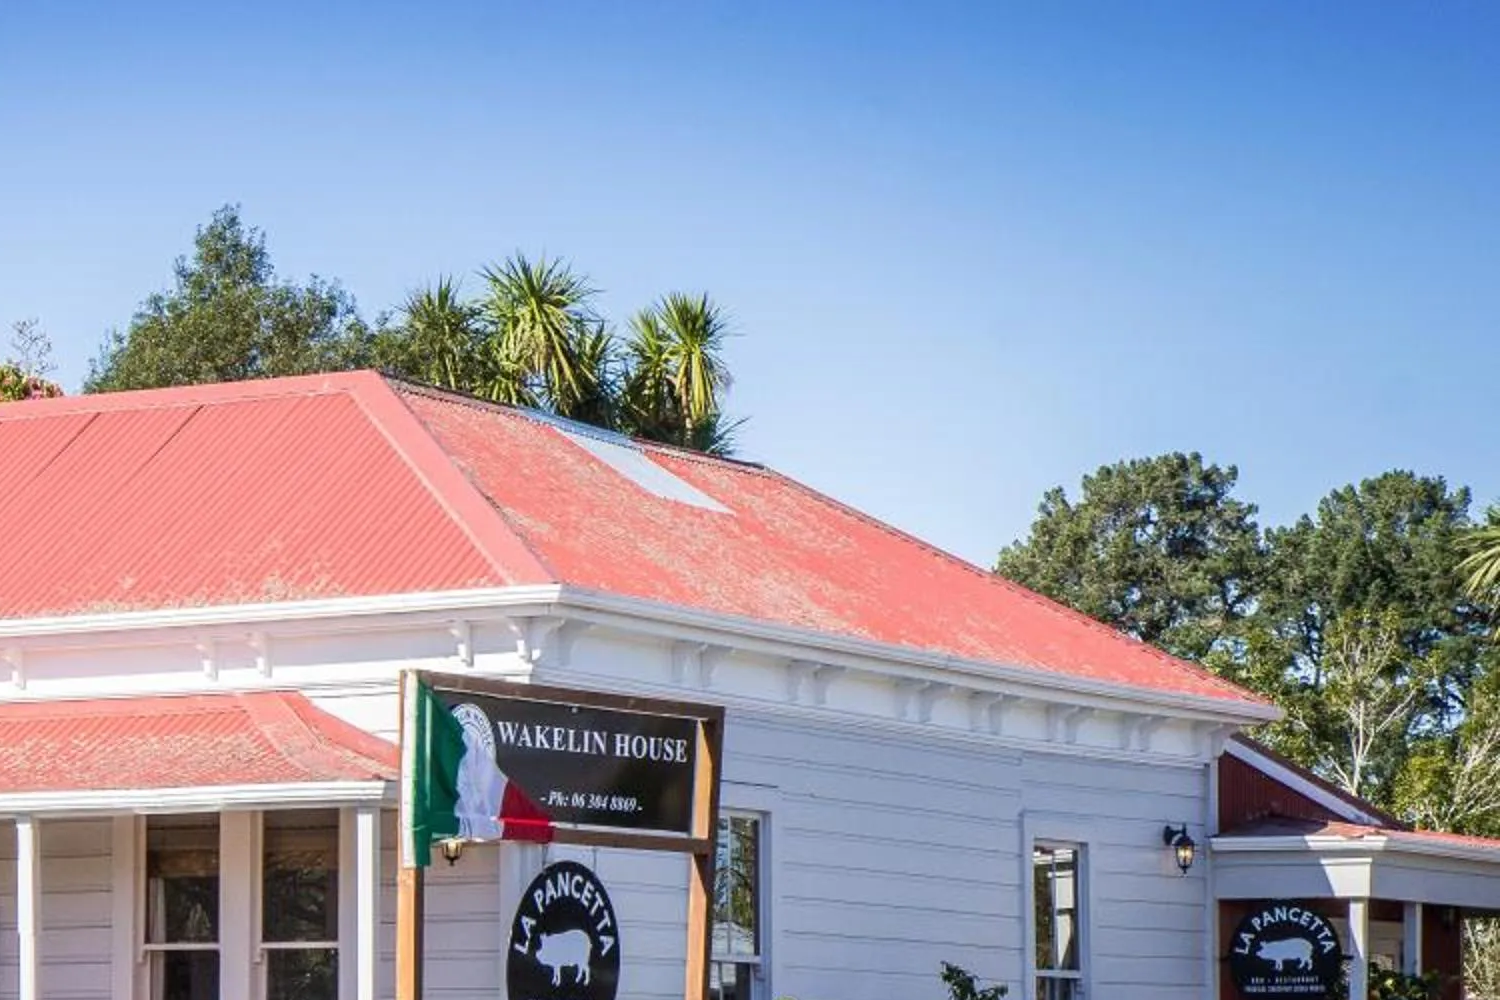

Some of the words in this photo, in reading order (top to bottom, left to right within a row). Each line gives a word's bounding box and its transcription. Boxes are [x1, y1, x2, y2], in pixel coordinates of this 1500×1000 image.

[498, 721, 607, 755] WAKELIN
[614, 733, 688, 763] HOUSE
[514, 915, 537, 955] LA
[534, 872, 614, 956] PANCETTA
[1235, 932, 1255, 955] LA
[1251, 906, 1336, 953] PANCETTA
